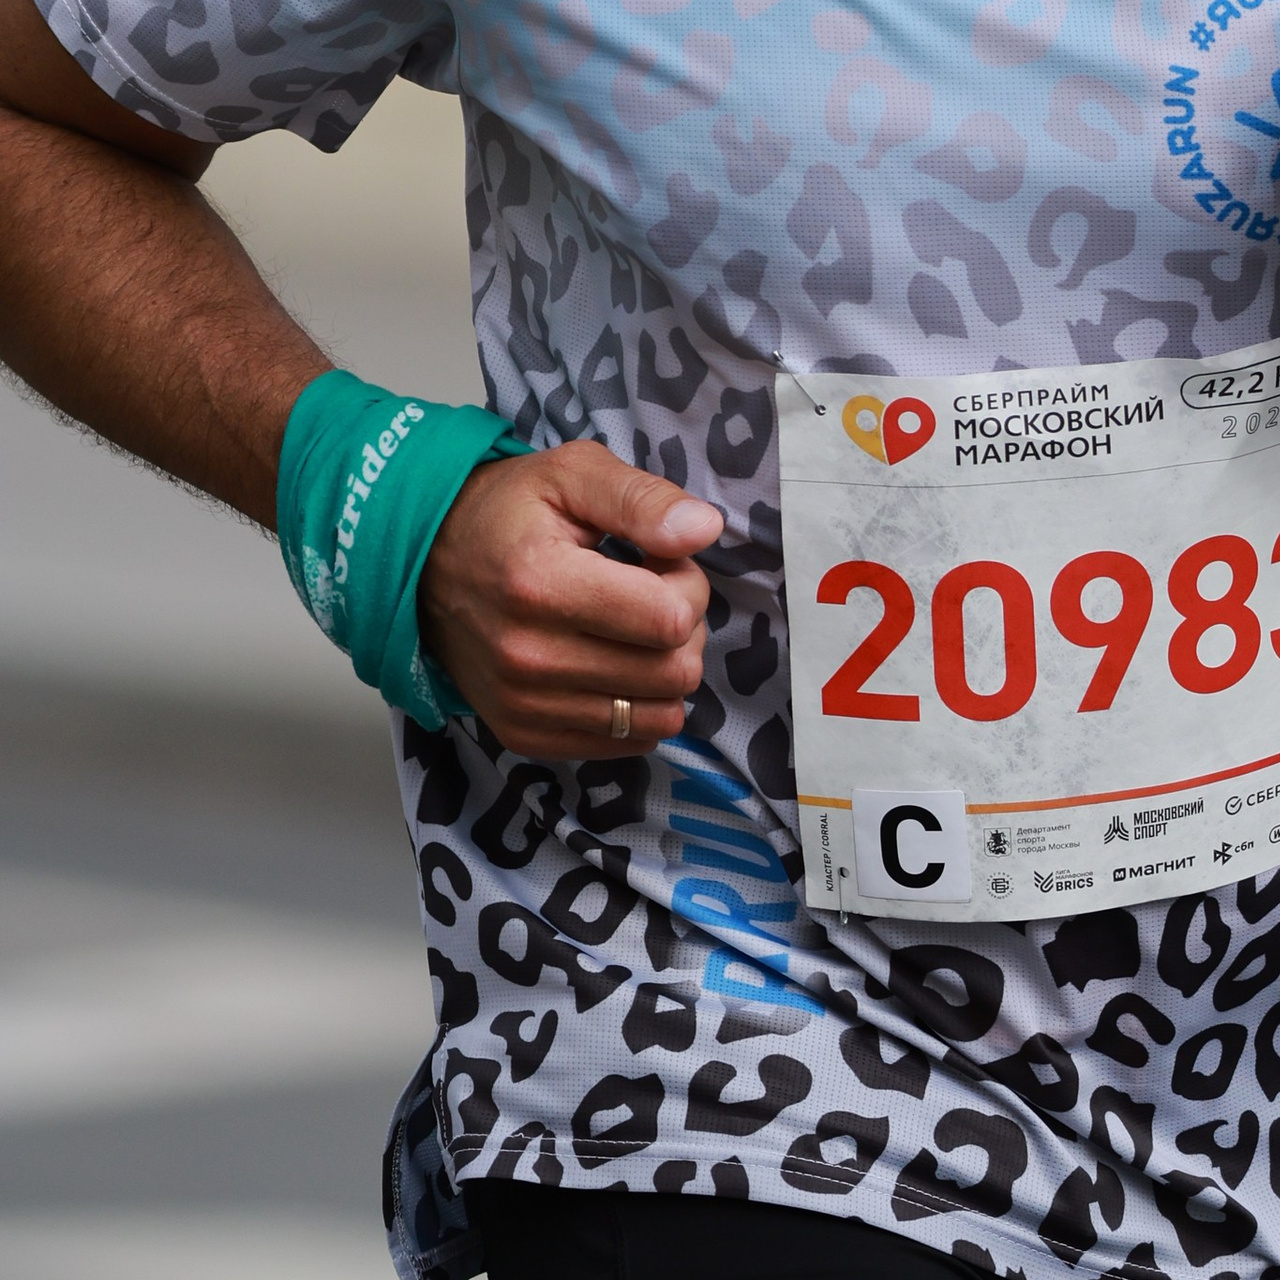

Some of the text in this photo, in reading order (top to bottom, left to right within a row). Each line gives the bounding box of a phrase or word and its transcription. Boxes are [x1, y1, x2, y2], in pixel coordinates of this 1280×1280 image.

[953, 384, 1110, 413] СБЕРПРАЙМ
[1199, 371, 1265, 400] 42,2
[954, 396, 1165, 440] МОСКОВСКИЙ
[955, 434, 1113, 466] МАРАФОН
[1133, 797, 1204, 826] МОСКОВСКИЙ
[819, 813, 830, 847] CORRAL
[1016, 823, 1071, 836] Департамент
[1017, 836, 1046, 845] спорта
[1134, 822, 1168, 840] СПОРТ
[879, 804, 946, 889] C
[1017, 841, 1080, 854] города Москвы
[823, 854, 834, 892] КЛАСТЕР
[1055, 871, 1094, 880] МАРАФОНОВ
[1129, 855, 1196, 878] магнит
[1055, 877, 1094, 892] BRICS
